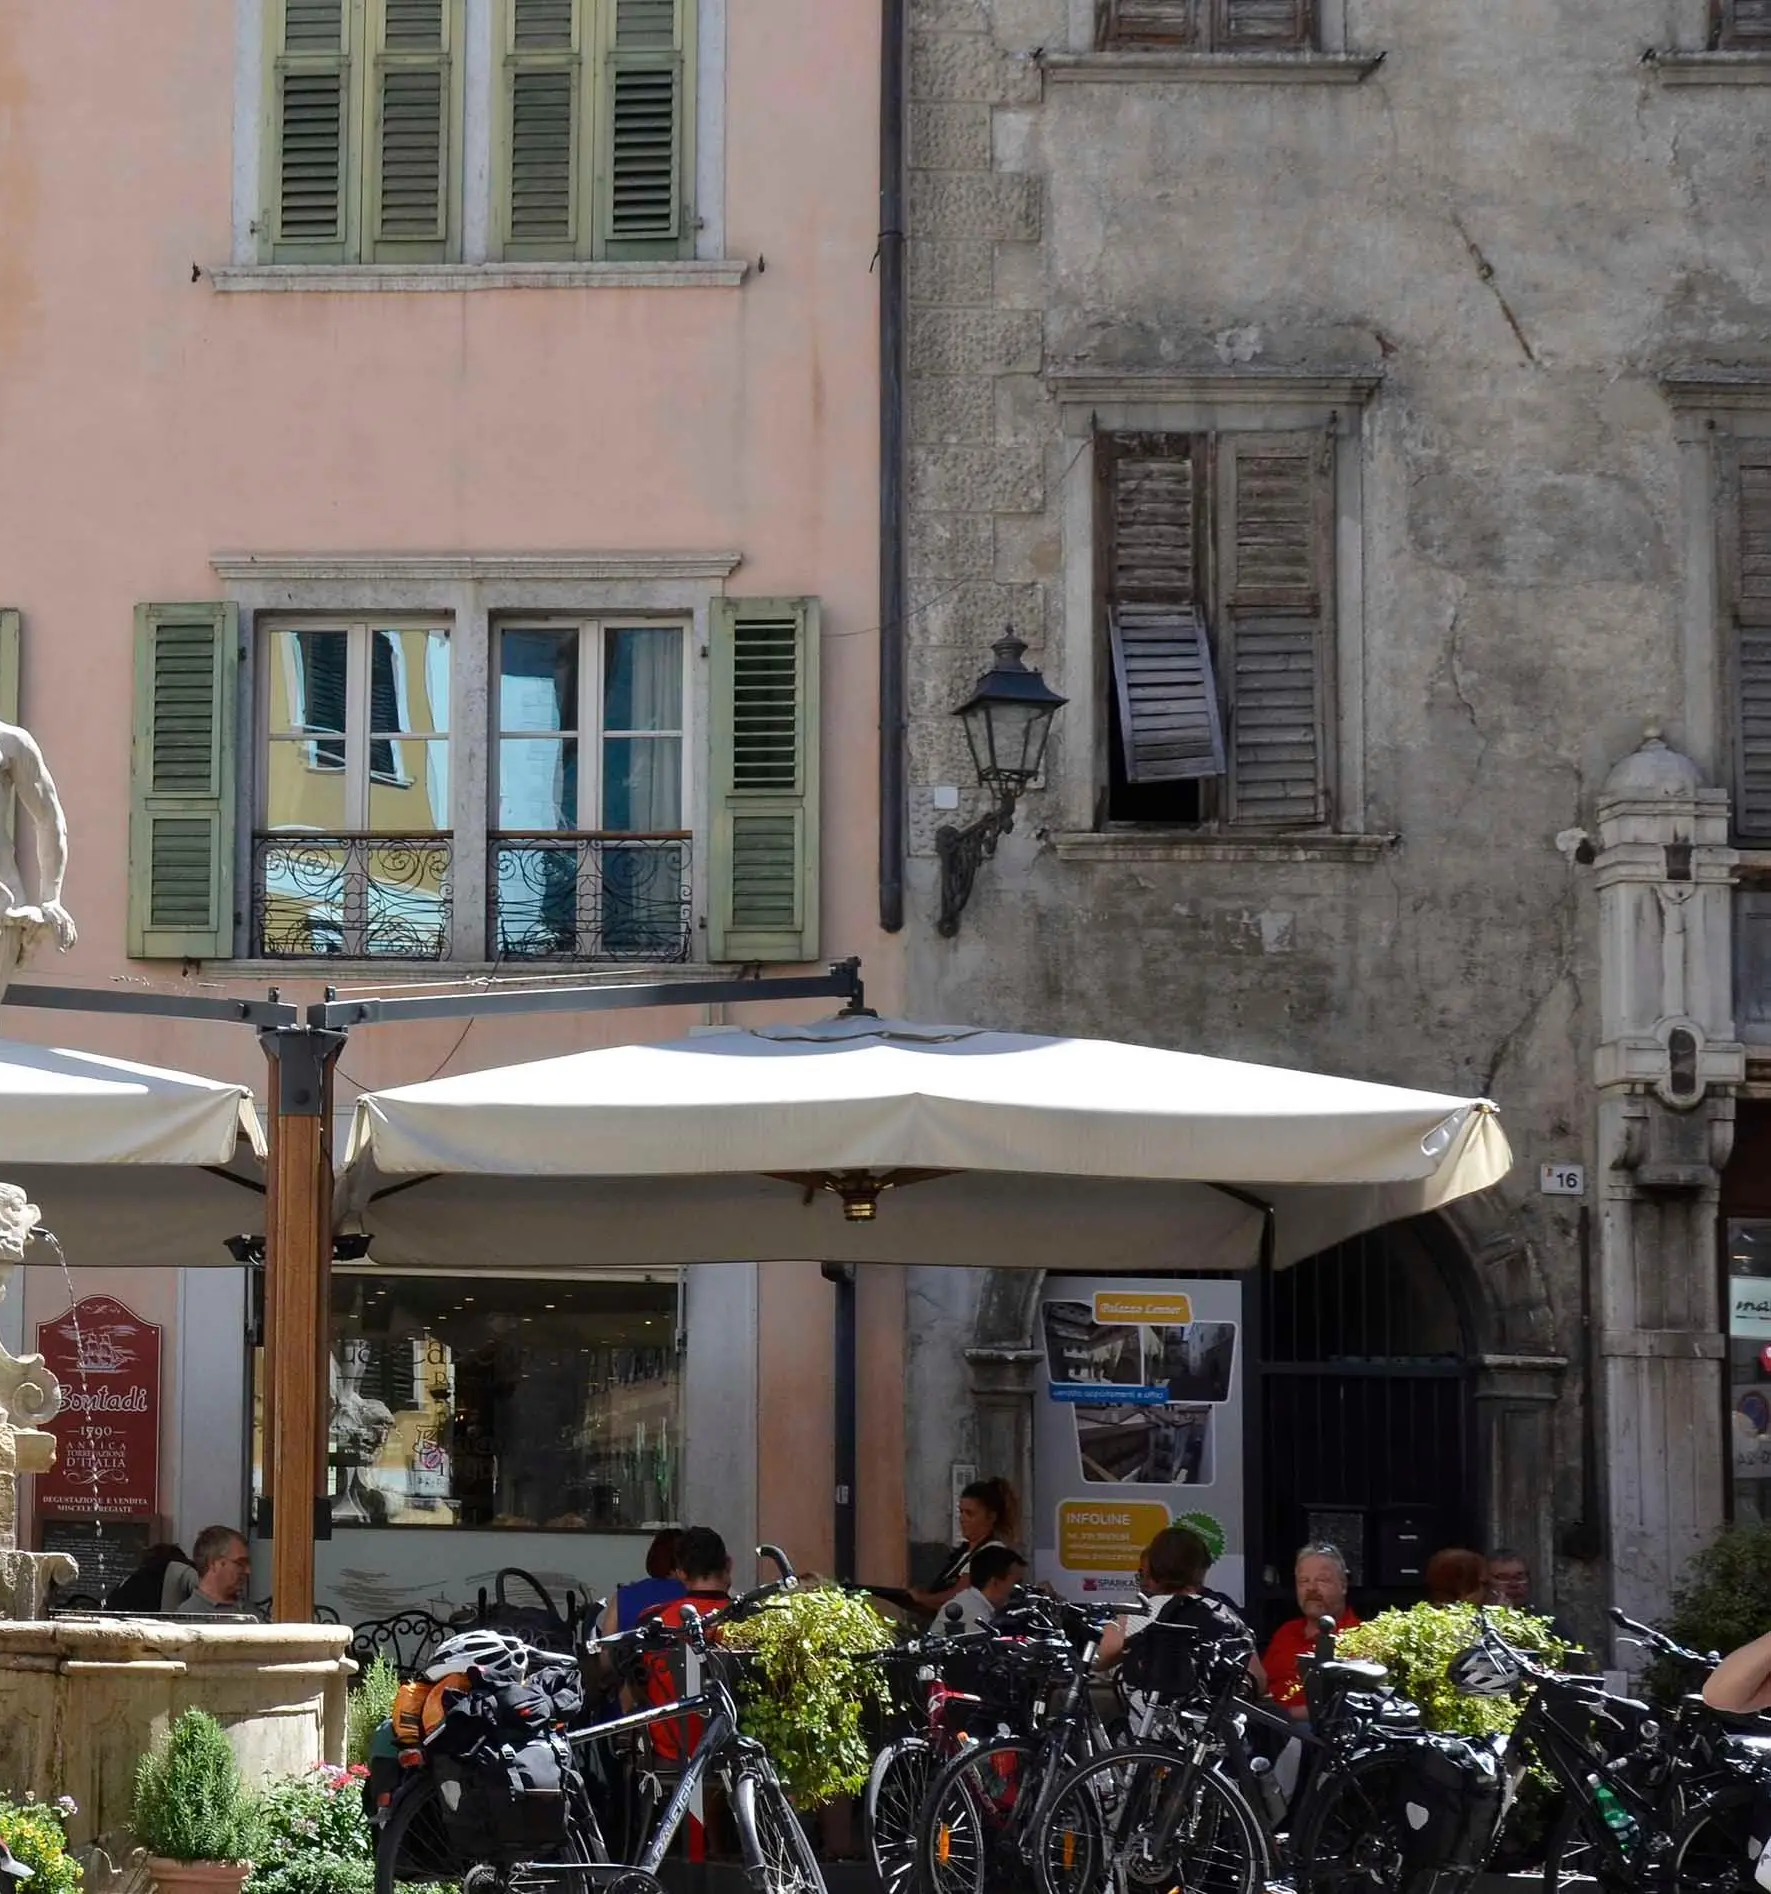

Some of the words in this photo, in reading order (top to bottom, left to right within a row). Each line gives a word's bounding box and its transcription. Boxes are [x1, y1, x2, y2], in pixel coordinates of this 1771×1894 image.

[1556, 1173, 1578, 1188] 16
[58, 1384, 148, 1412] Bontadi
[80, 1426, 113, 1440] 1790
[66, 1457, 126, 1468] D'ITALIA
[94, 1504, 132, 1513] REGIATE
[1066, 1512, 1132, 1526] INFOLINE
[1097, 1577, 1141, 1588] SPARKAS
